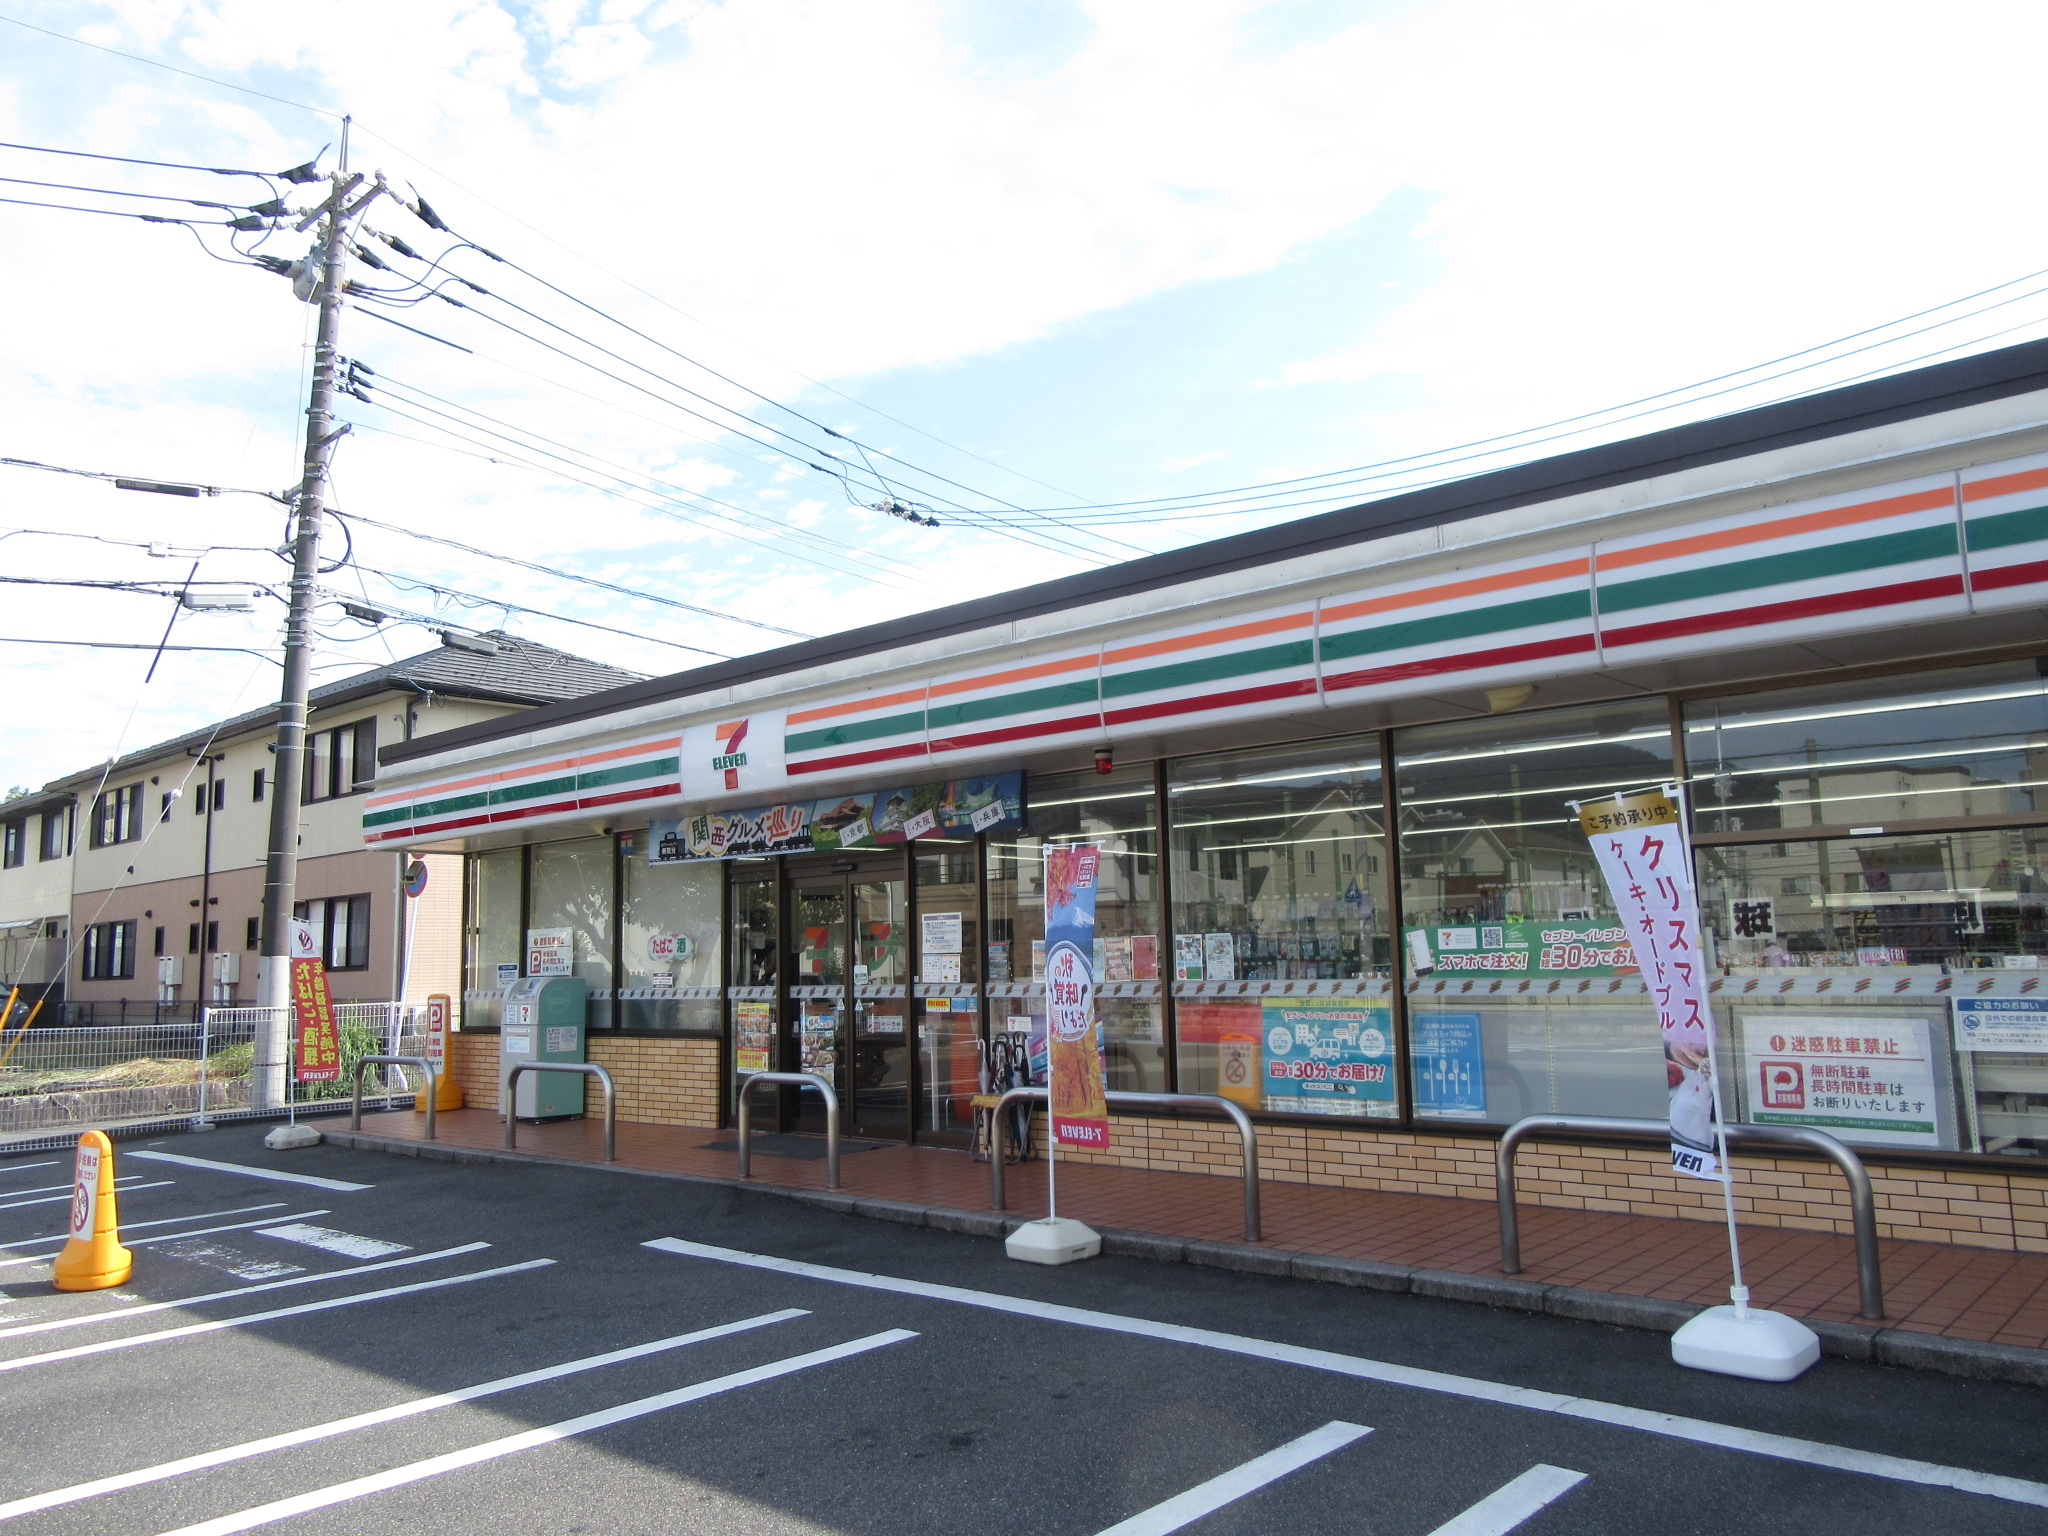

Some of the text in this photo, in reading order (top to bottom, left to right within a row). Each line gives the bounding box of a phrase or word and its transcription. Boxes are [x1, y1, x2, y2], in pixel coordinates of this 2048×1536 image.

[982, 806, 1000, 823] 兵庫
[1587, 804, 1668, 830] ご予約承り中
[692, 807, 804, 848] 関西グルメ巡り
[914, 816, 931, 831] 大阪
[1542, 929, 1629, 941] セブン-イレブン
[1639, 834, 1705, 1031] クリスマス
[653, 939, 673, 953] たばこ
[677, 938, 686, 953] 酒
[1439, 952, 1529, 970] スマホで注文!
[1974, 1001, 2039, 1010] ご協力のお願い
[1791, 1036, 1899, 1055] 迷惑駐車禁止
[1811, 1064, 1871, 1079] 無断駐車
[1811, 1079, 1904, 1096] 長時間駐車は
[1813, 1096, 1926, 1114] お断りいたします
